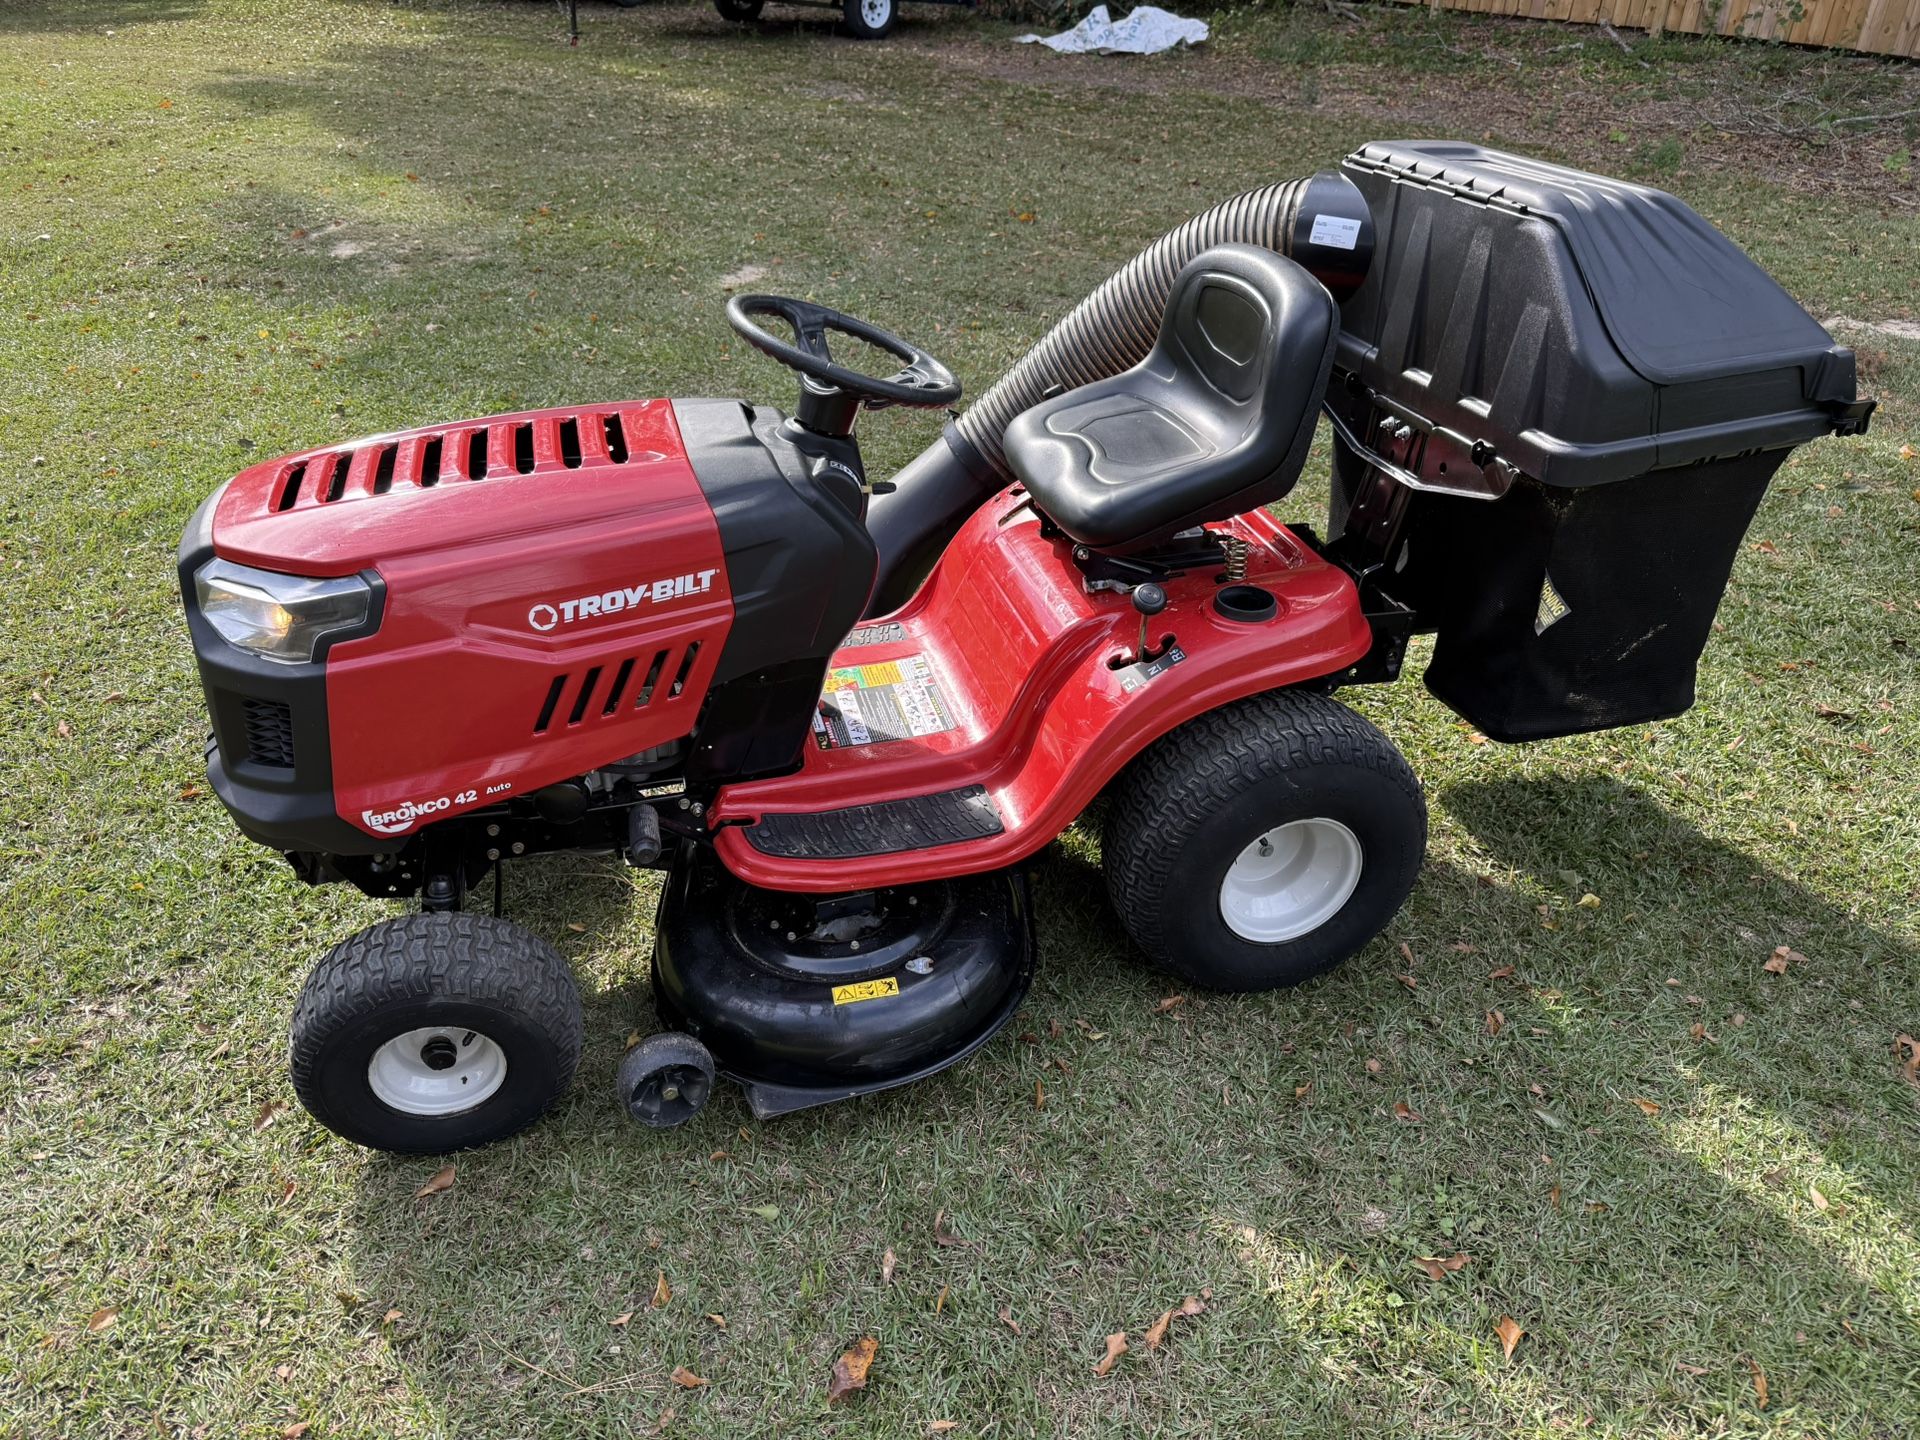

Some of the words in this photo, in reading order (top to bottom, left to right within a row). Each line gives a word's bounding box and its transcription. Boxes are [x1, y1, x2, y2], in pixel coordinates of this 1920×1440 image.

[559, 569, 716, 623] TROY-BILT
[370, 797, 451, 827] BRONCO
[454, 790, 479, 805] 42
[486, 782, 512, 795] Auto
